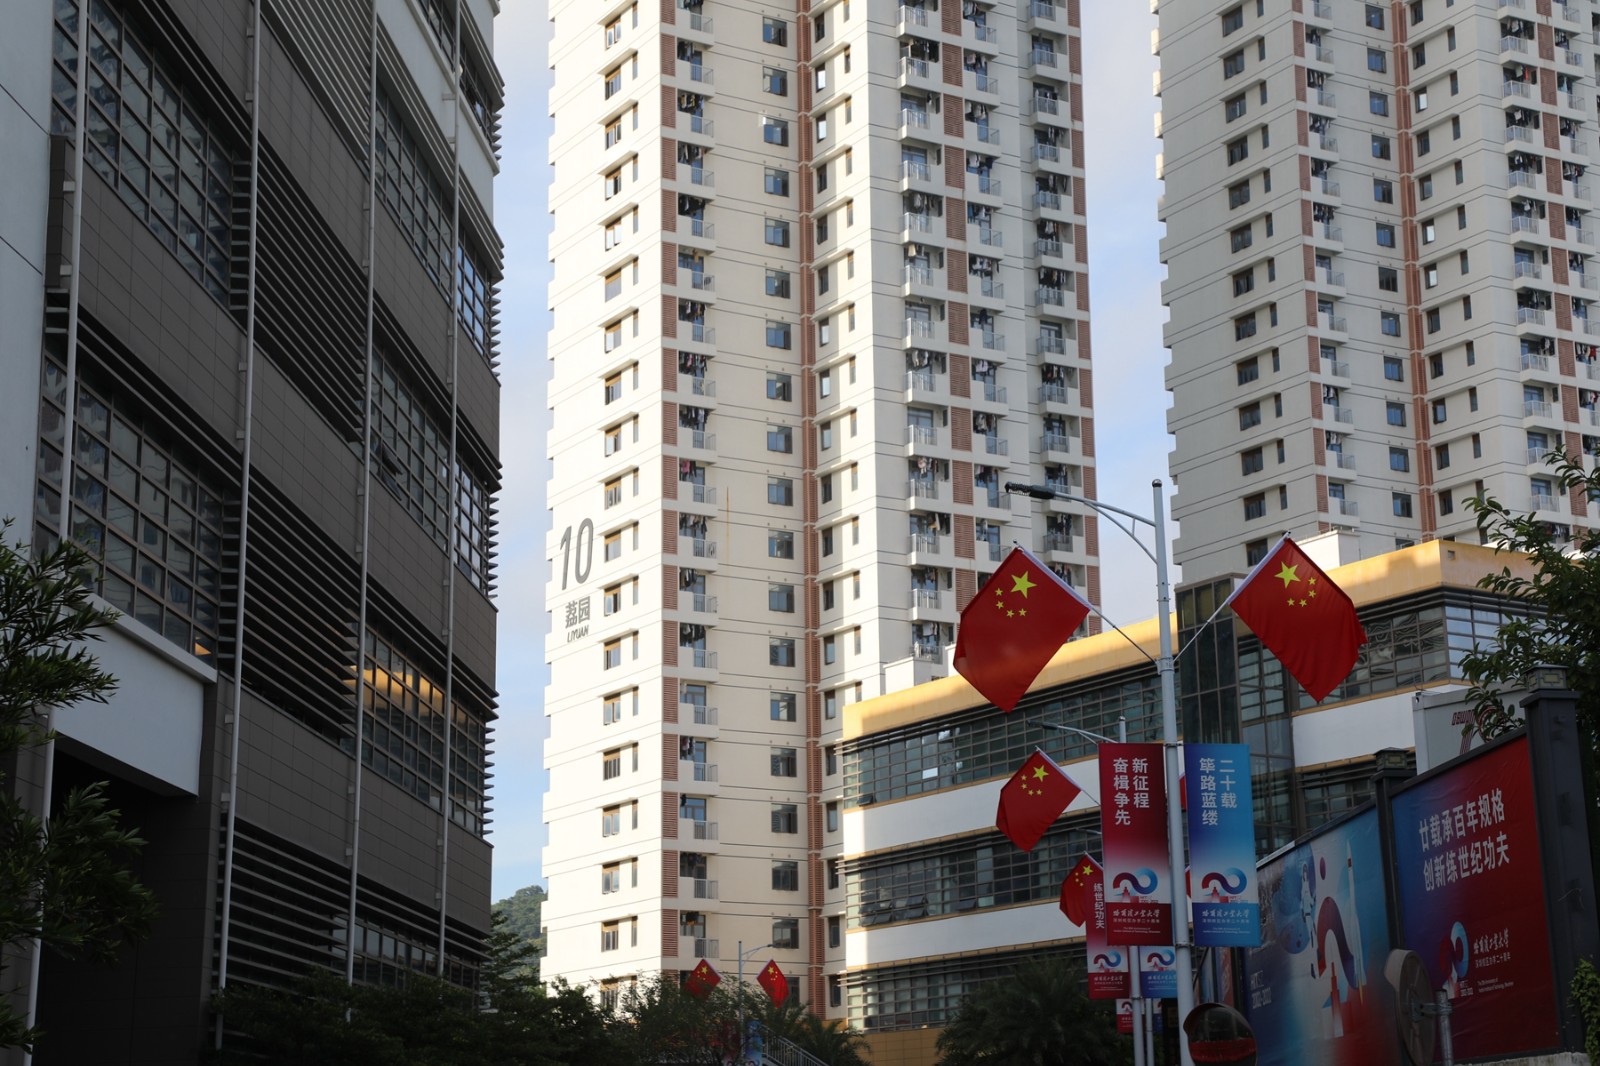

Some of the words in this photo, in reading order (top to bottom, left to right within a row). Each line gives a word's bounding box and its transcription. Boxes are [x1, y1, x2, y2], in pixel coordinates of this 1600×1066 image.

[560, 518, 594, 590] 10
[565, 596, 591, 629] 荔园
[567, 625, 589, 643] LIYUAN
[1113, 757, 1131, 826] 奋楫争先
[1131, 757, 1150, 809] 新征程
[1199, 757, 1218, 826] 筚路蓝缕
[1219, 759, 1237, 809] 二十载
[1418, 787, 1506, 853] 廿载承百年规格
[1423, 831, 1510, 892] 创新练世纪功夫
[1093, 883, 1105, 929] 练世纪功夫
